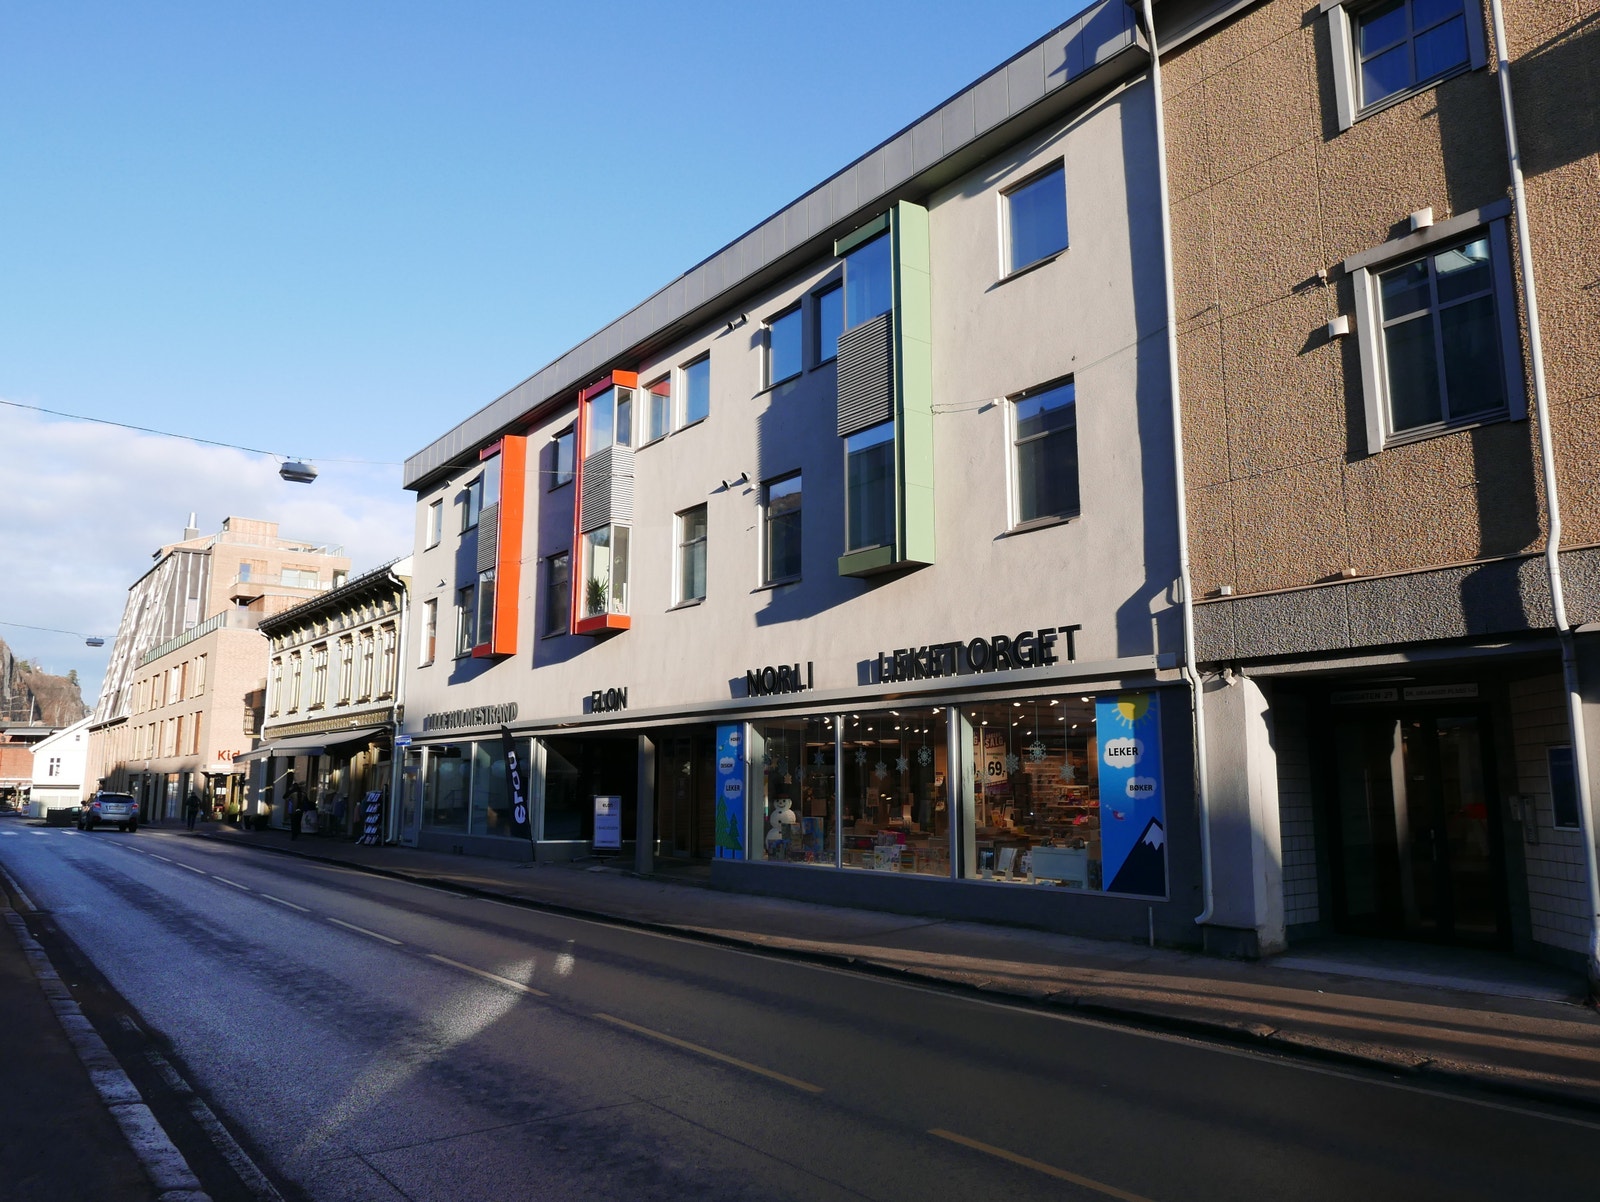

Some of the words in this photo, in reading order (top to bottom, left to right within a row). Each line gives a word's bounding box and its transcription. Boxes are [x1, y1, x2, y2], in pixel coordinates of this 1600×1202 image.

[747, 661, 813, 696] NORLI
[592, 686, 628, 713] ELON
[449, 702, 518, 728] HOLMESTRAND
[1108, 746, 1139, 756] LEKER
[1129, 784, 1153, 792] BØKER
